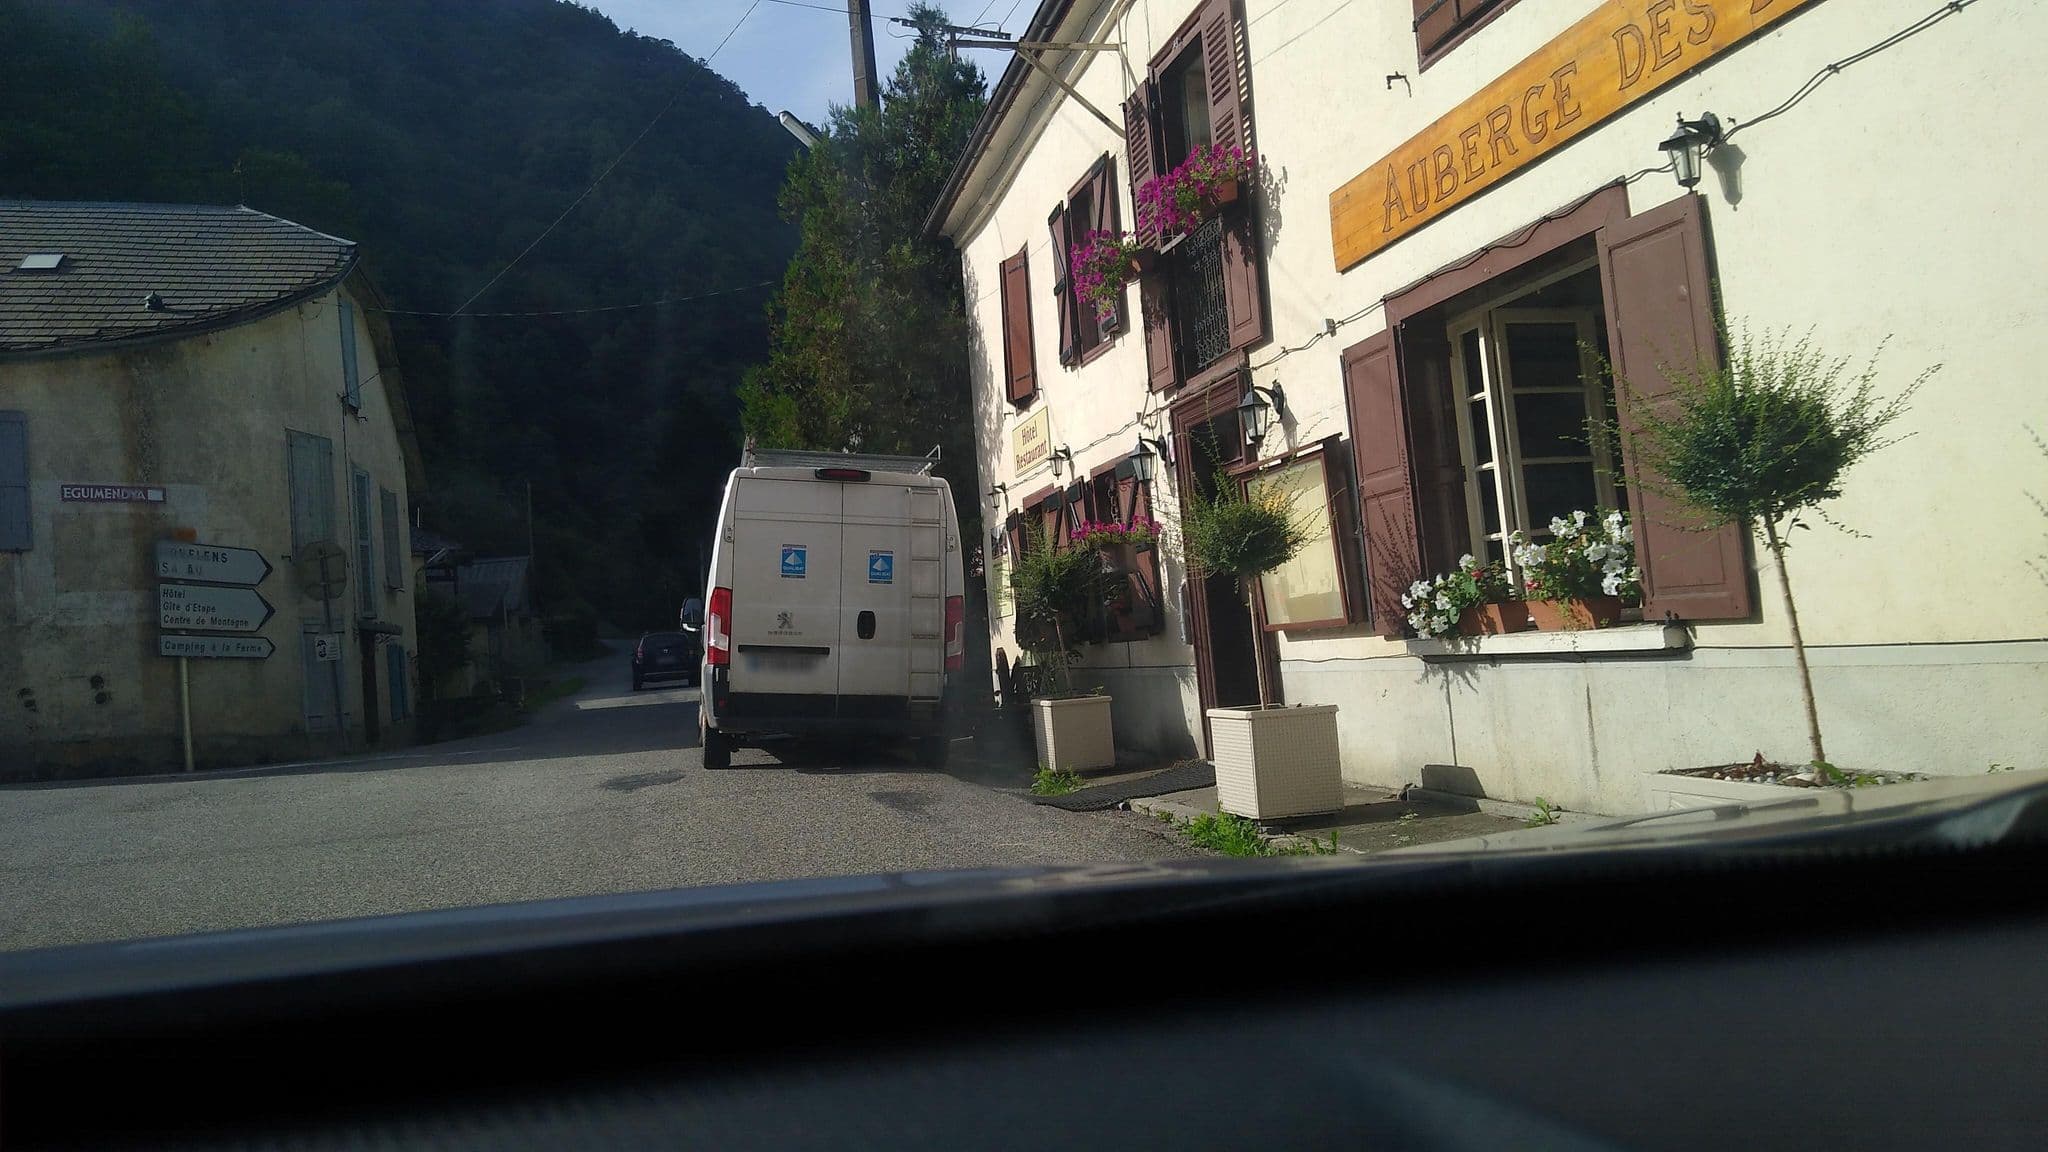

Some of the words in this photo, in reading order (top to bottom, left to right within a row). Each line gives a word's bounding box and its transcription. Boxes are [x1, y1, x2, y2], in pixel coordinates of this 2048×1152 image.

[1381, 60, 1583, 233] AUBERGE
[1612, 0, 1716, 91] DES
[1022, 420, 1037, 446] Hôtel
[1016, 439, 1047, 471] Restaurant
[162, 588, 186, 598] Hôtel
[162, 601, 181, 611] Gîte
[163, 614, 190, 624] Centre
[196, 616, 206, 625] de
[211, 617, 249, 628] Montagne
[165, 641, 205, 652] Camping
[222, 642, 230, 651] la
[236, 643, 262, 652] Ferme
